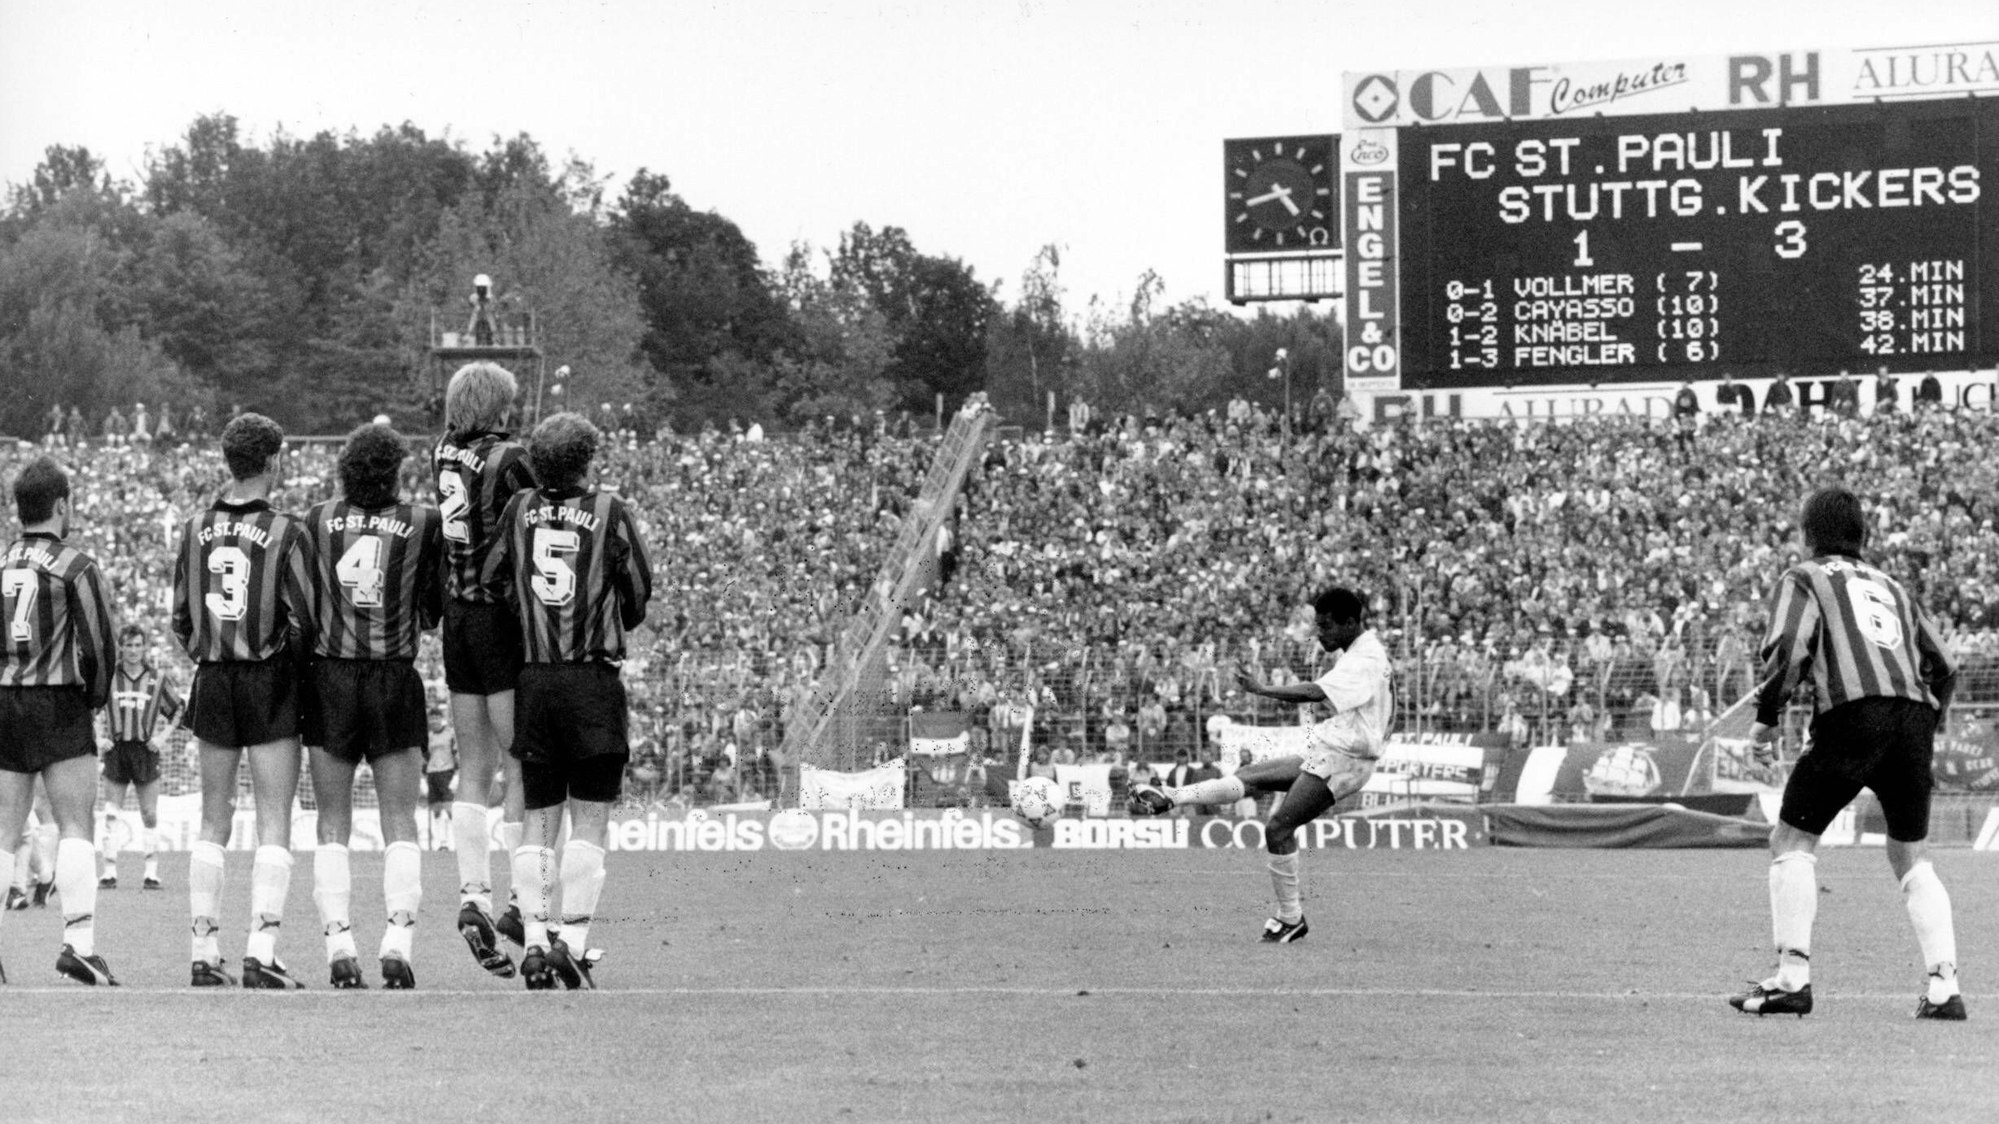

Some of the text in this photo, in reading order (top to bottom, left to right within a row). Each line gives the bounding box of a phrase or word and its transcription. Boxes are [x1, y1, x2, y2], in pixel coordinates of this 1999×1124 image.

[1409, 62, 1686, 120] CAF Computer
[1729, 52, 1820, 105] RH
[1430, 141, 1496, 182] FC
[1357, 176, 1385, 320] ENGEL
[1573, 229, 1594, 267] 1
[1774, 219, 1807, 259] 3
[1446, 279, 1495, 301] 0-1
[1513, 273, 1634, 297] VOLLMER
[1446, 301, 1498, 324] 0-2
[1513, 296, 1634, 321] CAYASSO
[1656, 294, 1719, 316] (10)
[1360, 321, 1383, 344] &
[1449, 324, 1499, 347] 1-2
[1513, 319, 1618, 345] KNÄBEL
[1656, 317, 1719, 339] (10)
[1347, 344, 1396, 372] CO
[1449, 347, 1499, 370] 1-3
[1513, 343, 1635, 368] FENGLER
[325, 516, 345, 534] FC
[368, 515, 415, 539] PAULI
[438, 469, 470, 545] 2
[523, 508, 538, 529] FC
[557, 505, 601, 532] PAULI
[197, 526, 213, 547] FC
[232, 521, 274, 549] PAULI
[204, 546, 252, 621] 3
[335, 534, 385, 608] 4
[530, 527, 580, 606] 5
[1, 567, 40, 642] 7
[1845, 576, 1904, 651] 6
[821, 807, 1022, 851] Rheinfels
